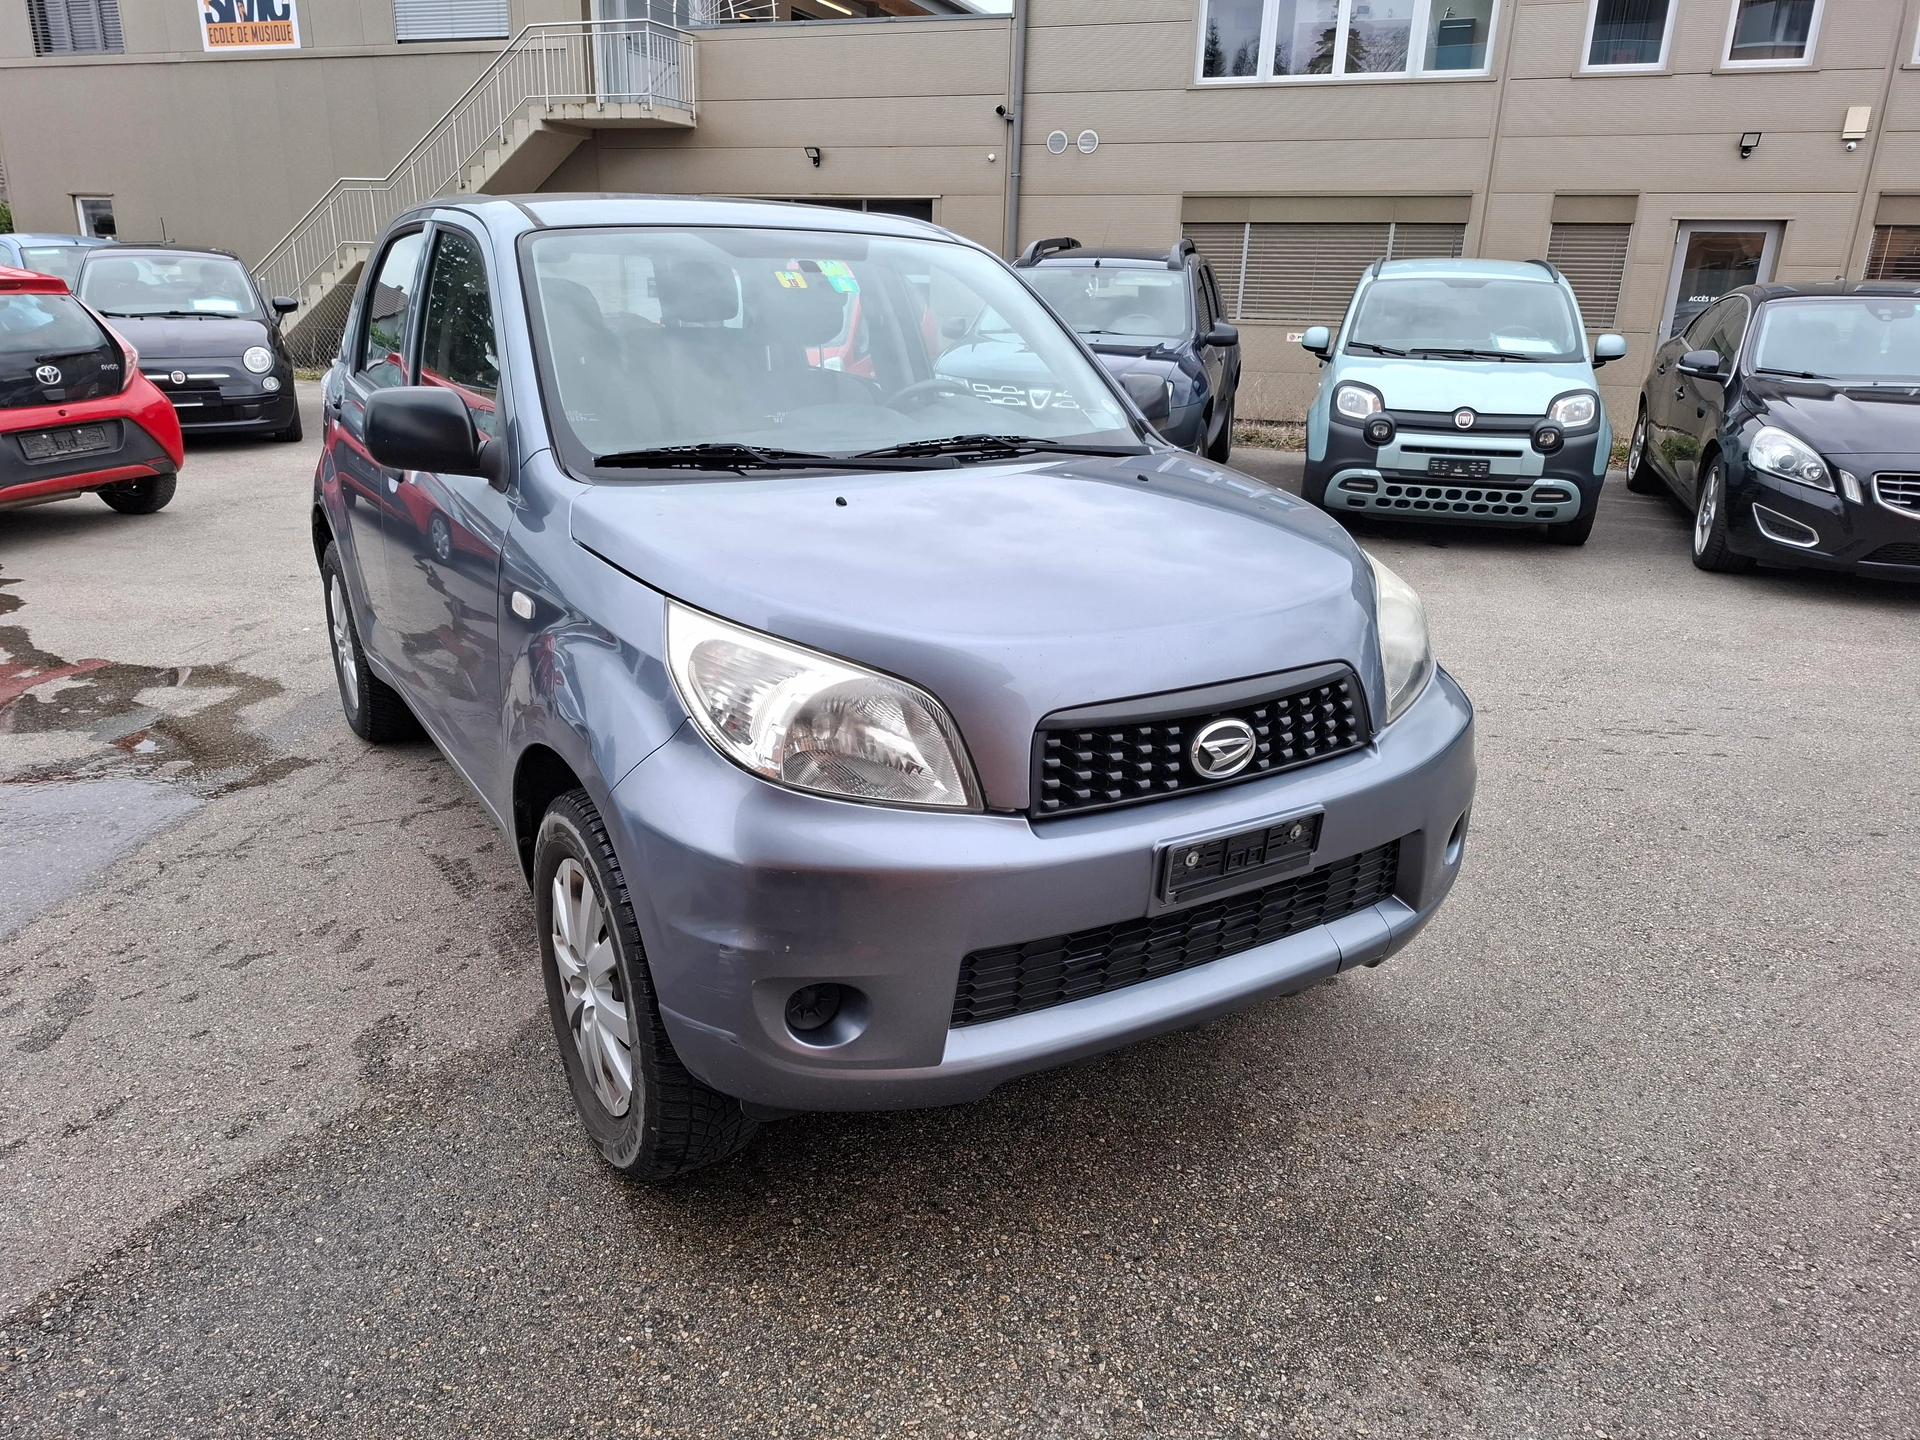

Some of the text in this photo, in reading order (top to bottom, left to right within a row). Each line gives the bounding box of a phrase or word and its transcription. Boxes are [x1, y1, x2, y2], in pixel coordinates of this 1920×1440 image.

[208, 24, 292, 44] ECOLE DE MUSIQUE
